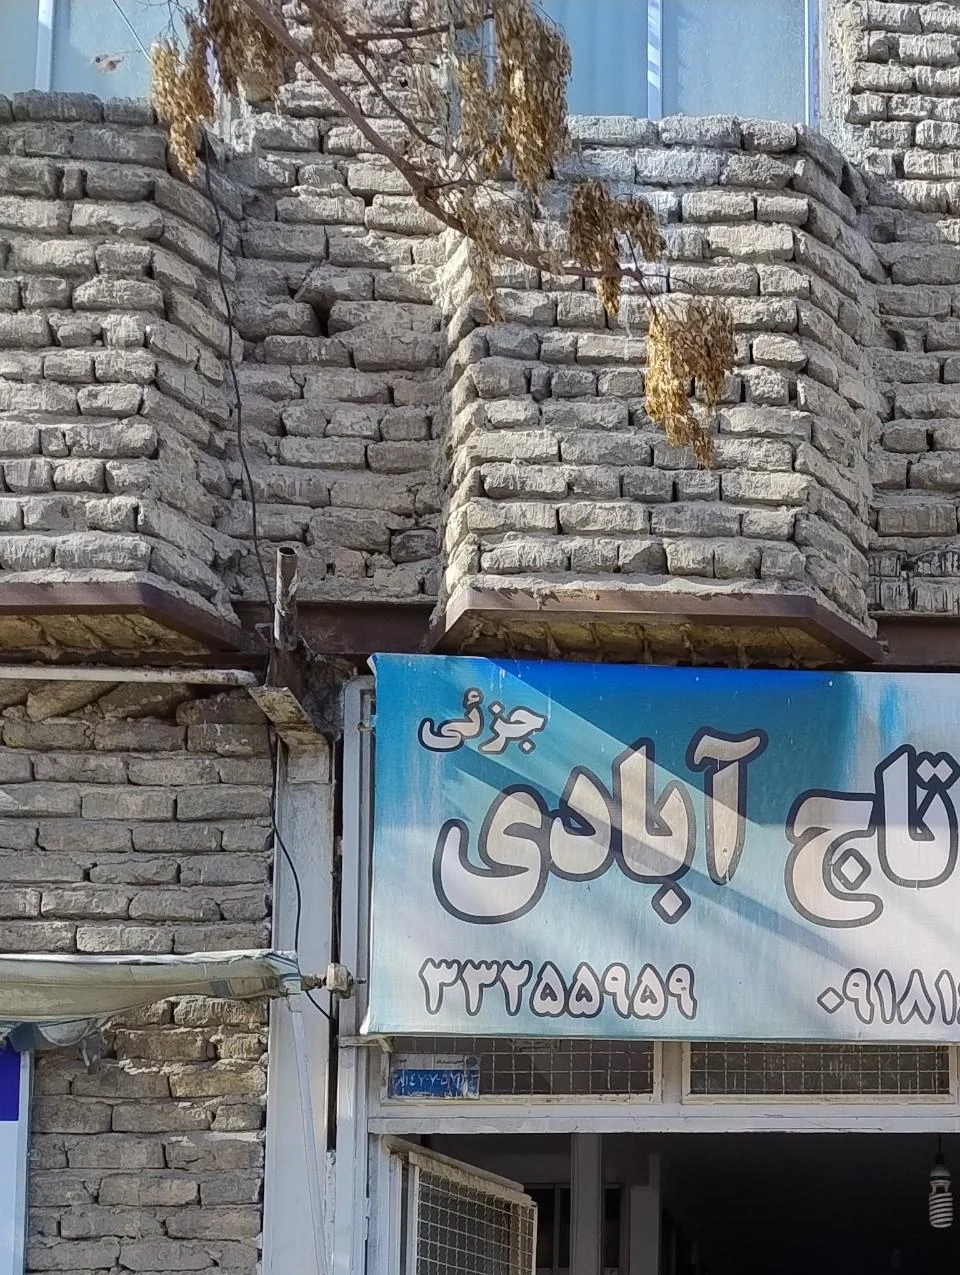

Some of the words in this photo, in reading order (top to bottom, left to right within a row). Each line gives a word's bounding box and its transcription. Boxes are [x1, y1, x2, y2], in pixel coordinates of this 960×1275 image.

[417, 687, 547, 753] جزئی
[432, 727, 768, 925] آبادی
[785, 744, 960, 928] تاج
[419, 957, 698, 1020] ۳۳۲۵۵۹۵۹
